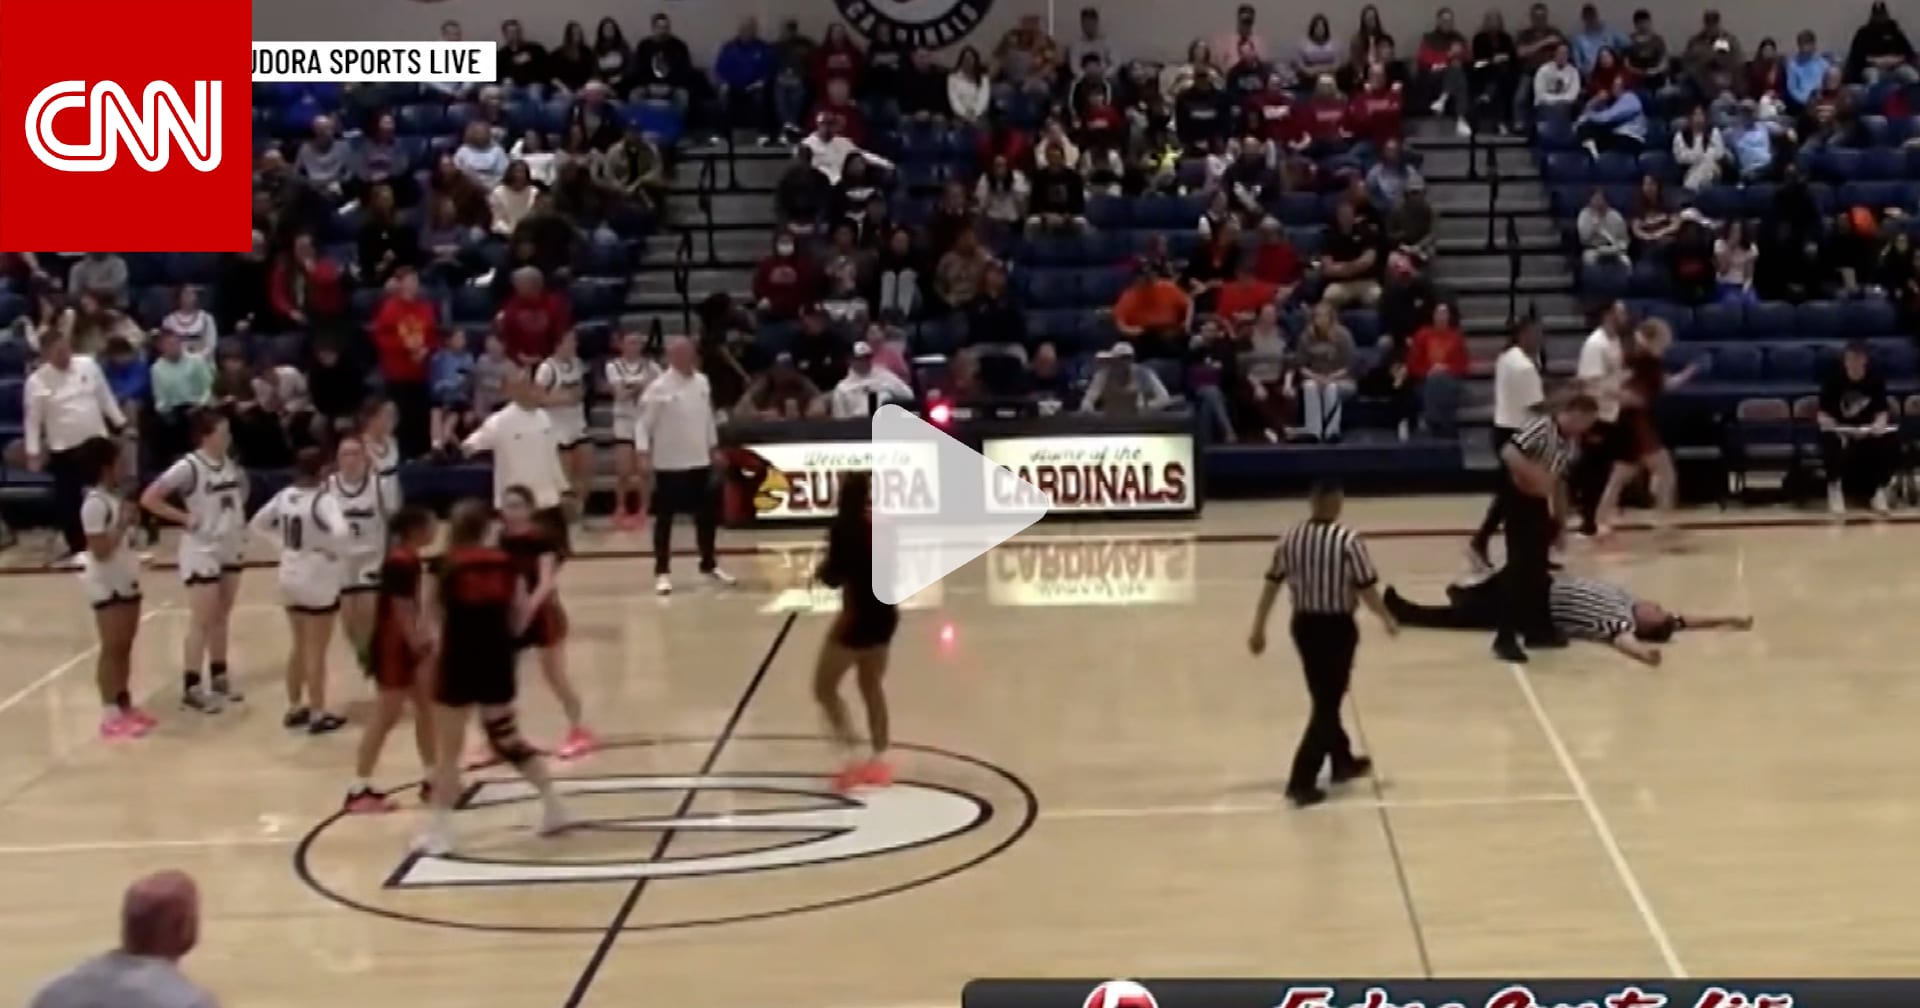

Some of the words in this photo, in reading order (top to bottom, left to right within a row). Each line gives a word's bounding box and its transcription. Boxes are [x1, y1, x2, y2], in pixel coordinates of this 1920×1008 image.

[844, 0, 978, 47] CADINALS
[788, 469, 934, 510] EURA
[992, 462, 1186, 505] CARDINALS
